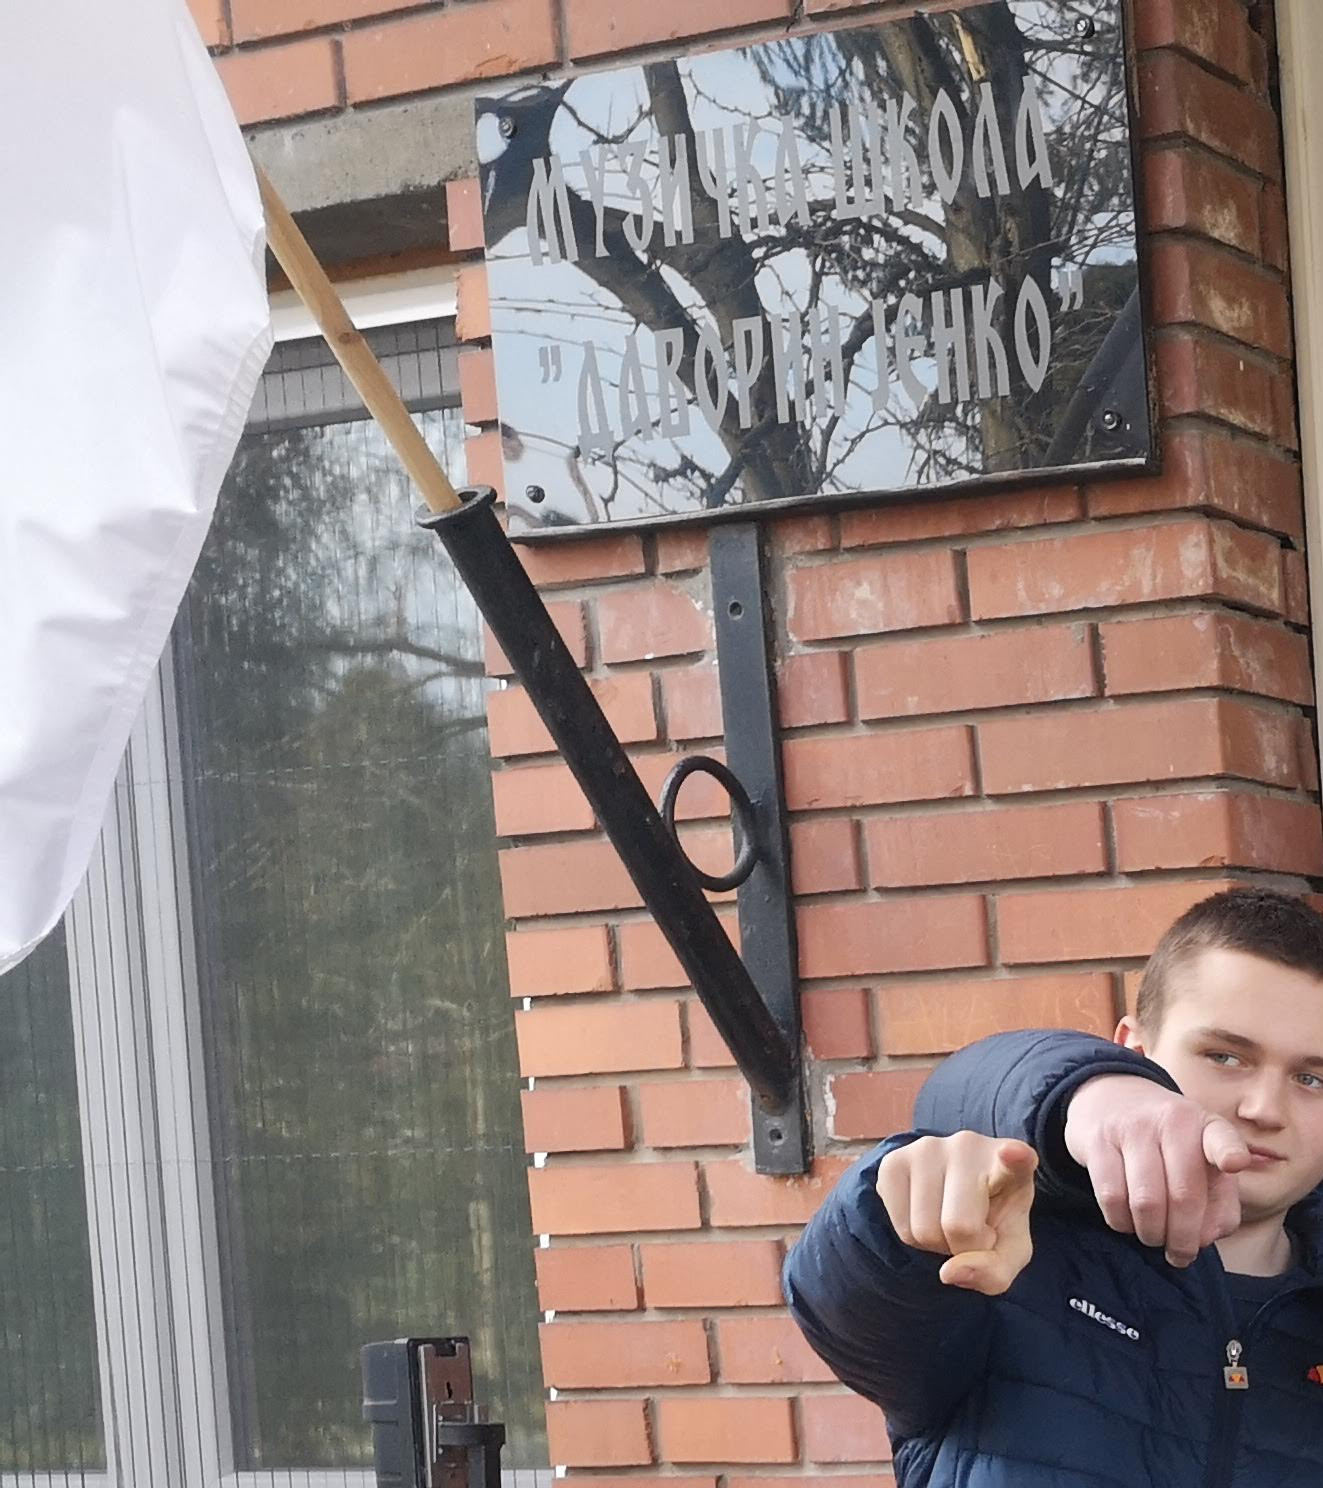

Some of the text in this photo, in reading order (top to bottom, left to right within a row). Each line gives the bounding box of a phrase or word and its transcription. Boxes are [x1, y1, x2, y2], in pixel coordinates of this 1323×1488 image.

[526, 74, 1055, 267] МУЗИЧКА ШКОЛА
[1069, 1298, 1140, 1340] ellesse
